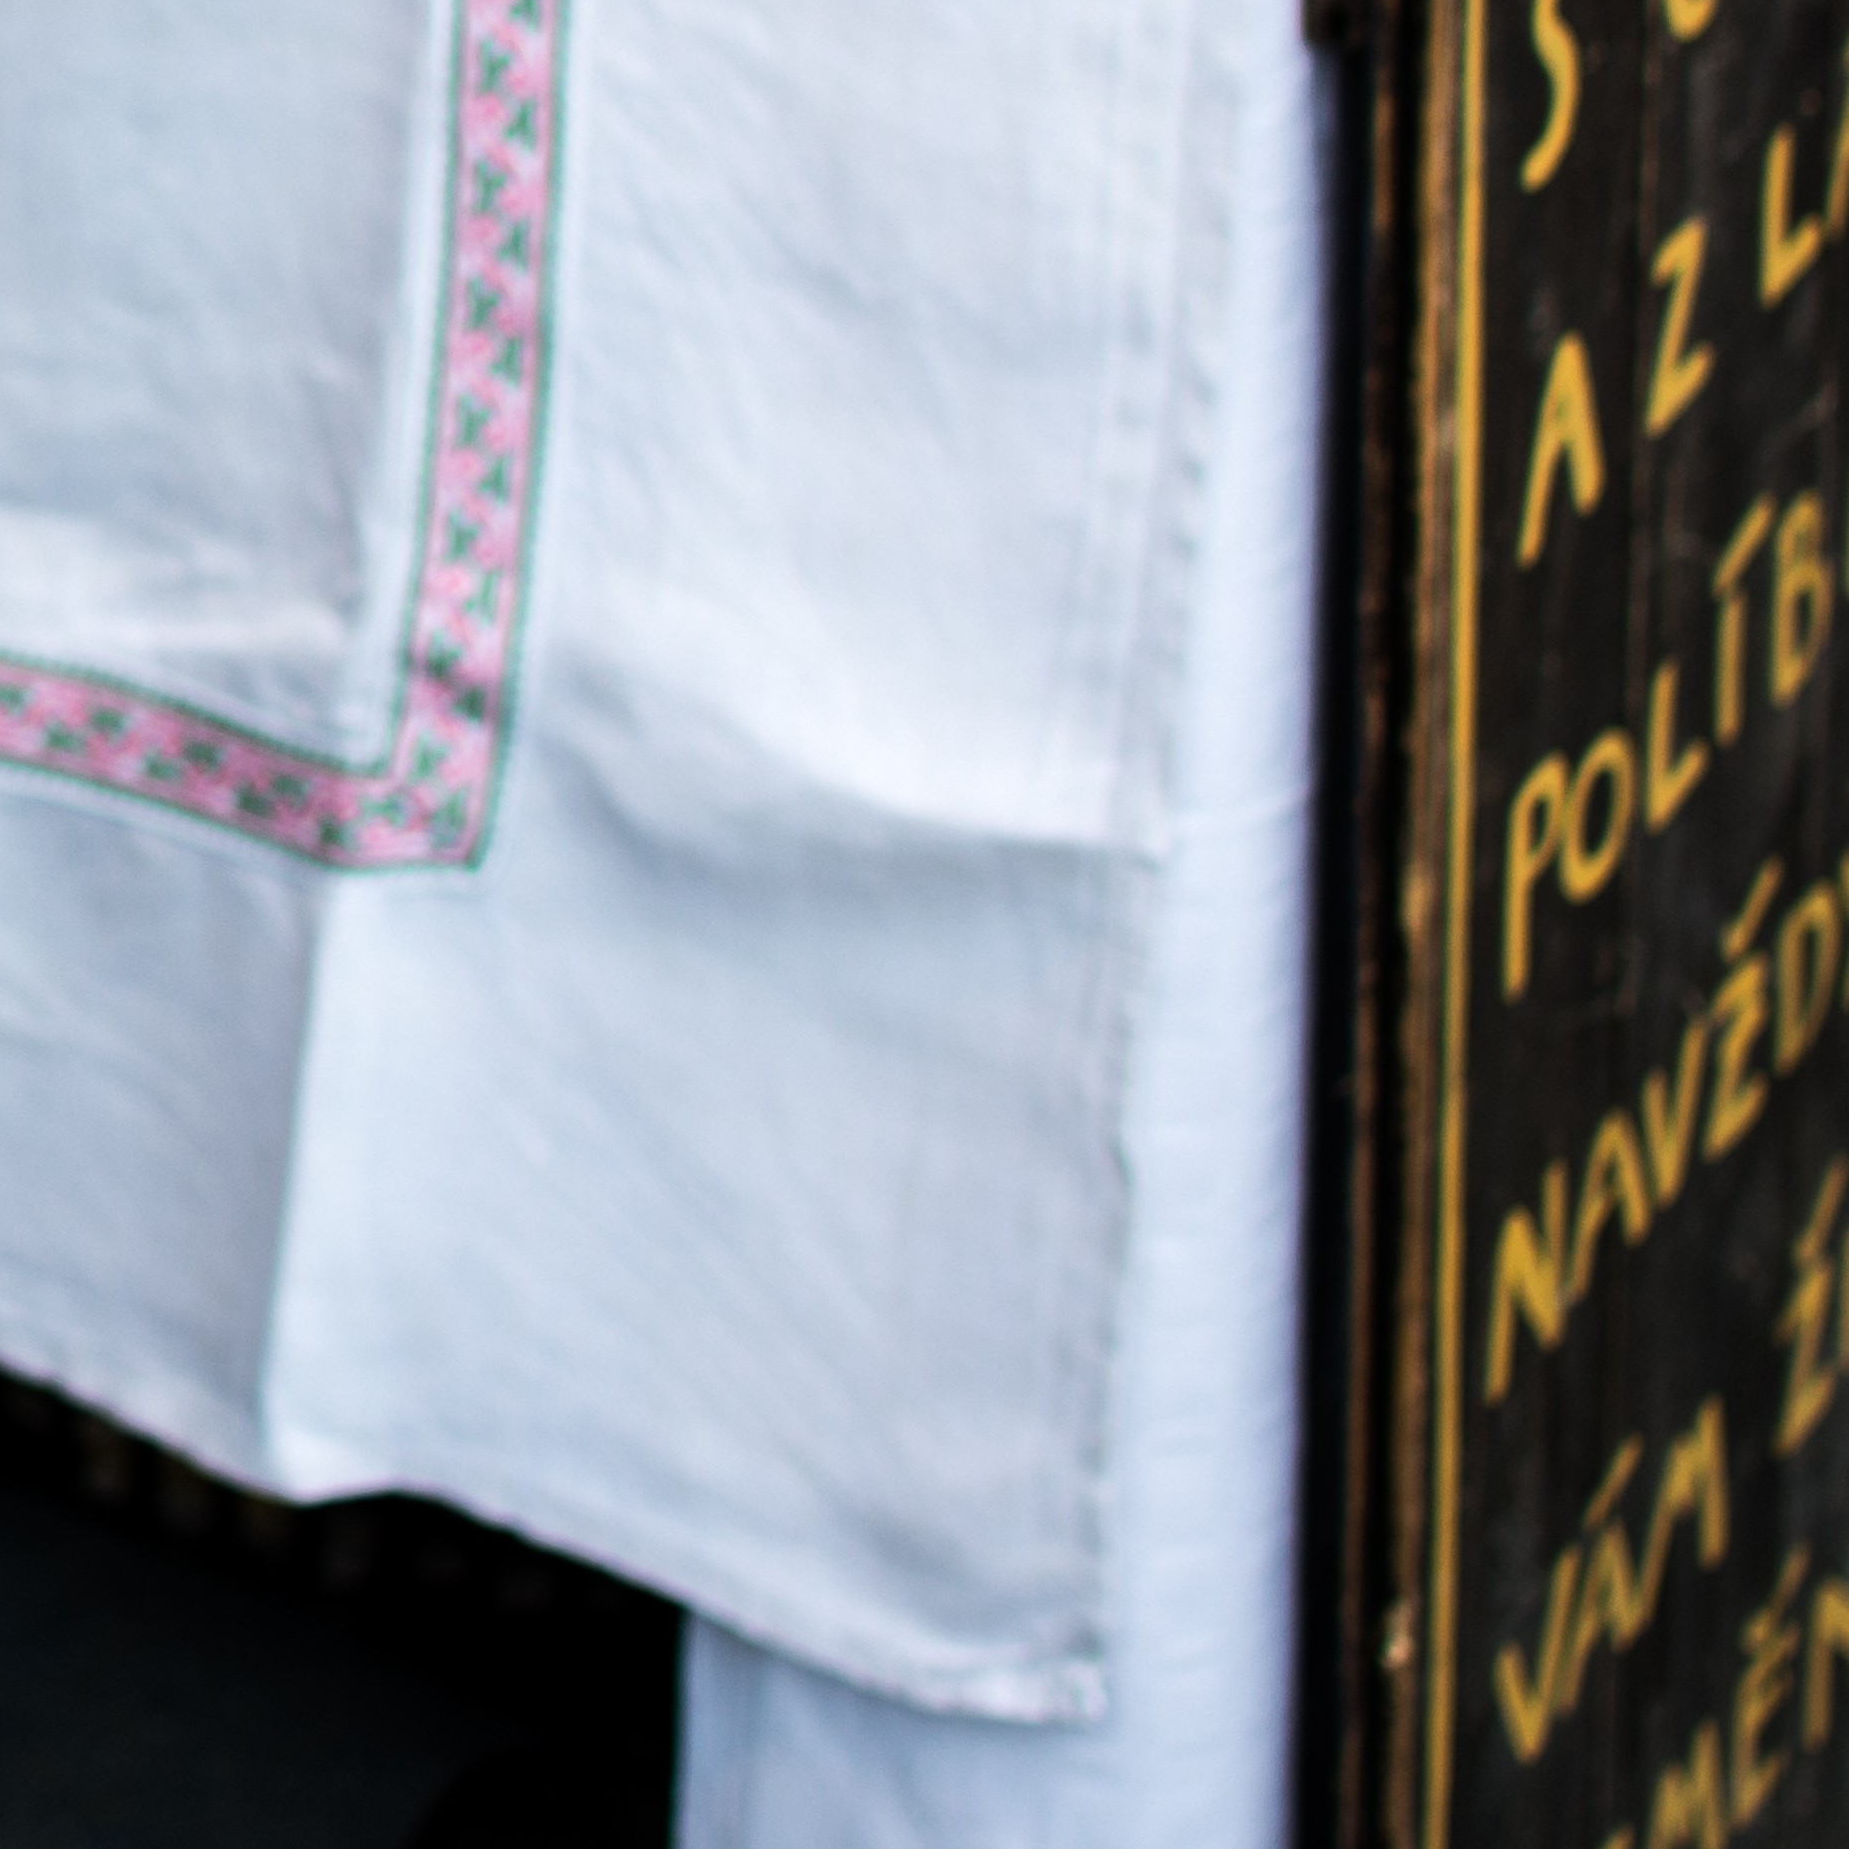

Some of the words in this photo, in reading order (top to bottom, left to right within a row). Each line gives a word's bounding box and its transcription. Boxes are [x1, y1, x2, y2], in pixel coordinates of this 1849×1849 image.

[1516, 330, 1603, 570] A
[1646, 215, 1713, 438] Z
[1501, 490, 1849, 1005] POLÍB
[1484, 850, 1849, 1407] NAVŽD
[1494, 1393, 1731, 1767] VÁM
[1773, 1150, 1849, 1455] Ž
